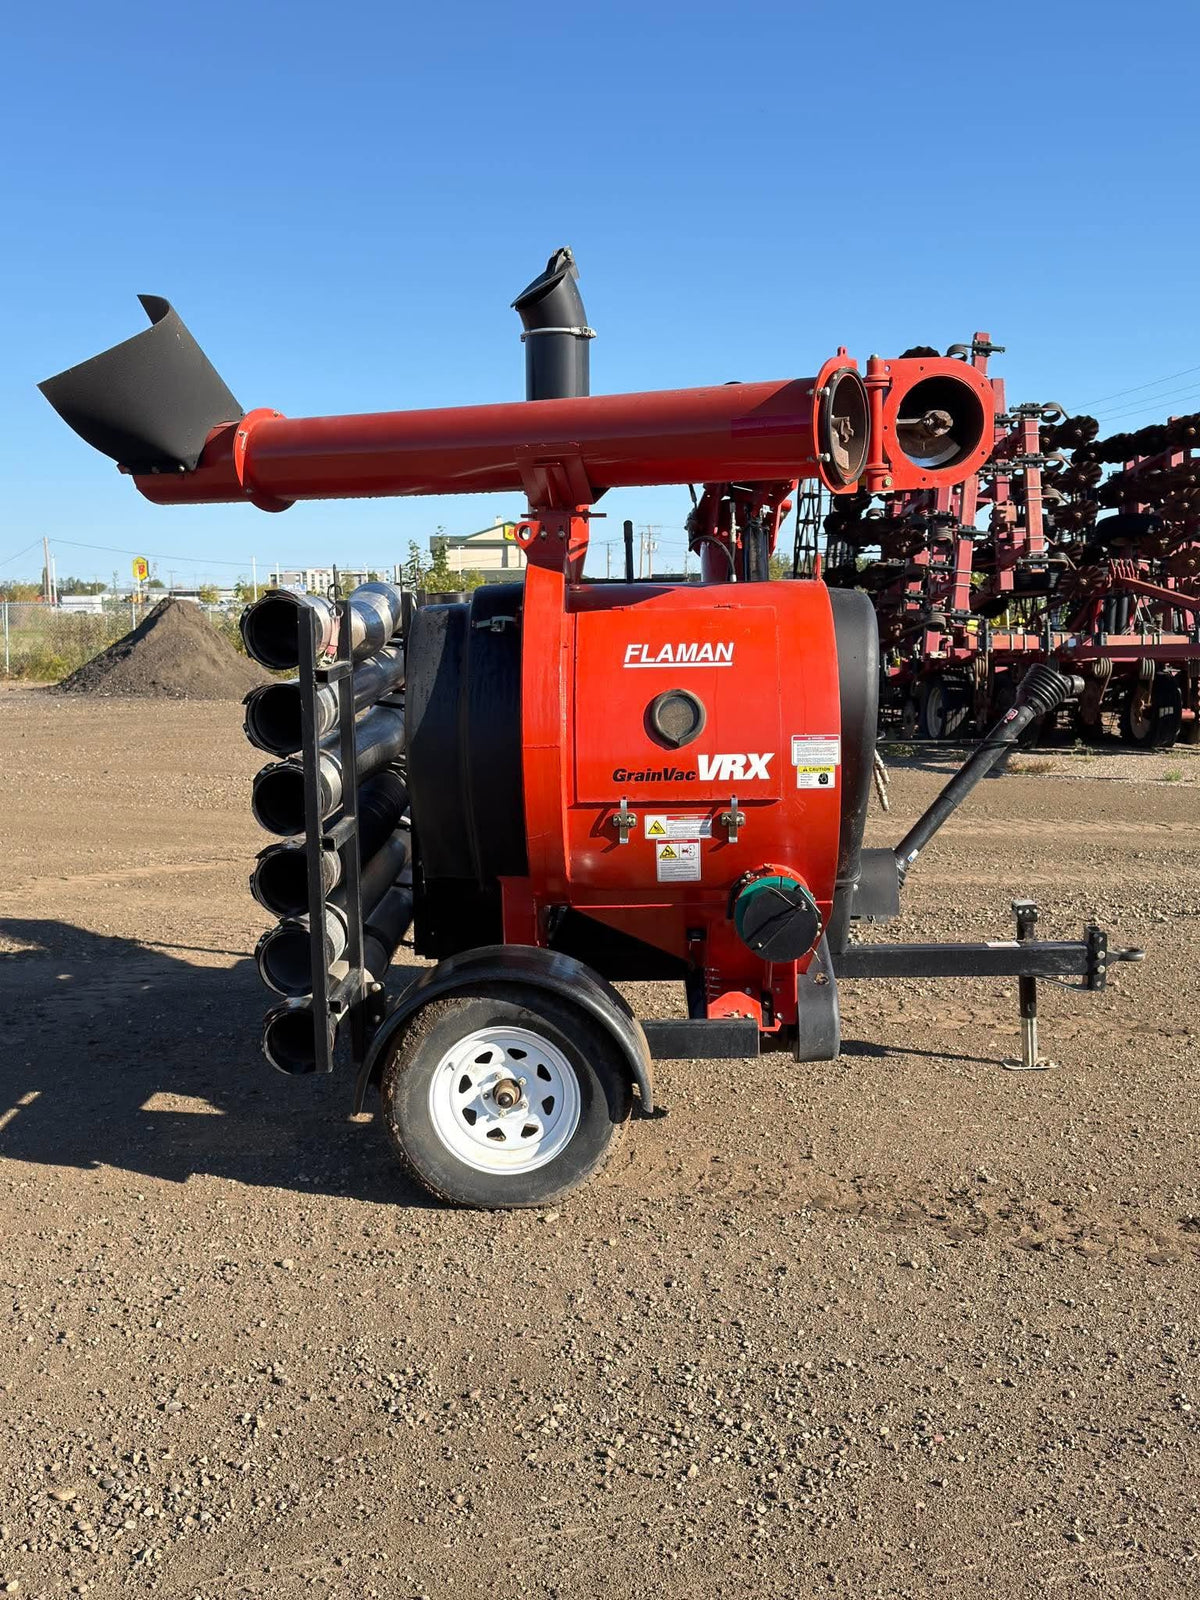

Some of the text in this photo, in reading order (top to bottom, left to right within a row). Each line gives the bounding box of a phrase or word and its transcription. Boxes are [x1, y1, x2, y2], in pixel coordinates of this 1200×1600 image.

[623, 642, 734, 663] FLAMAN
[612, 768, 696, 782] GrainVac
[697, 753, 775, 781] VRX
